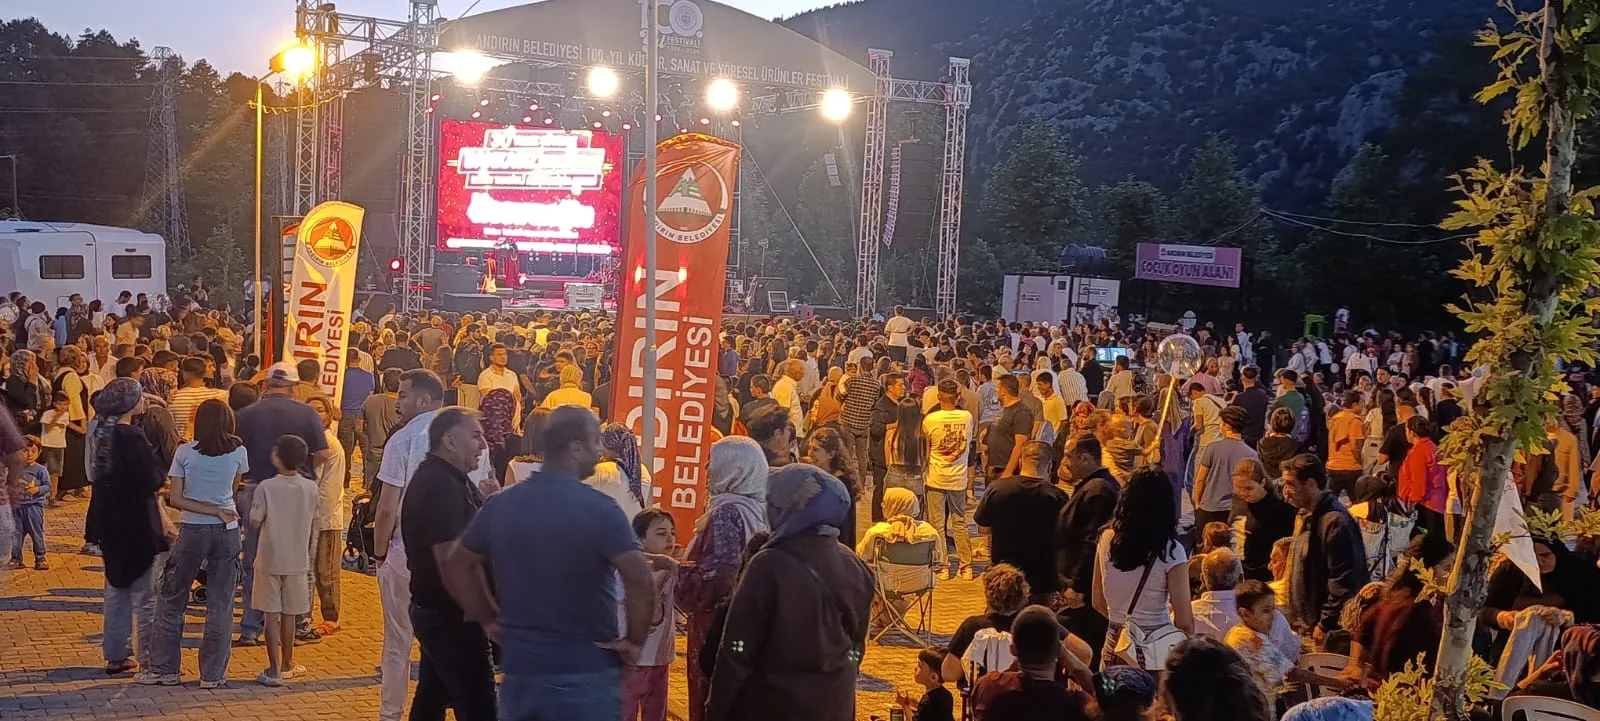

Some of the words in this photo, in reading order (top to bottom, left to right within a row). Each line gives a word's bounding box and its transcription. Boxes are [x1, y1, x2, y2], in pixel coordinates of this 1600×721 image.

[475, 34, 520, 52] ANDIRIN
[523, 40, 583, 60] BELEDİYESİ
[609, 50, 625, 65] YIL
[628, 50, 667, 71] KÜLR.
[671, 57, 701, 74] SANAT
[704, 62, 715, 75] VE
[293, 281, 327, 360] IRIN
[322, 310, 345, 398] LEDİYESİ
[625, 268, 683, 509] DIRIN
[671, 316, 713, 509] BELEDİYESİ
